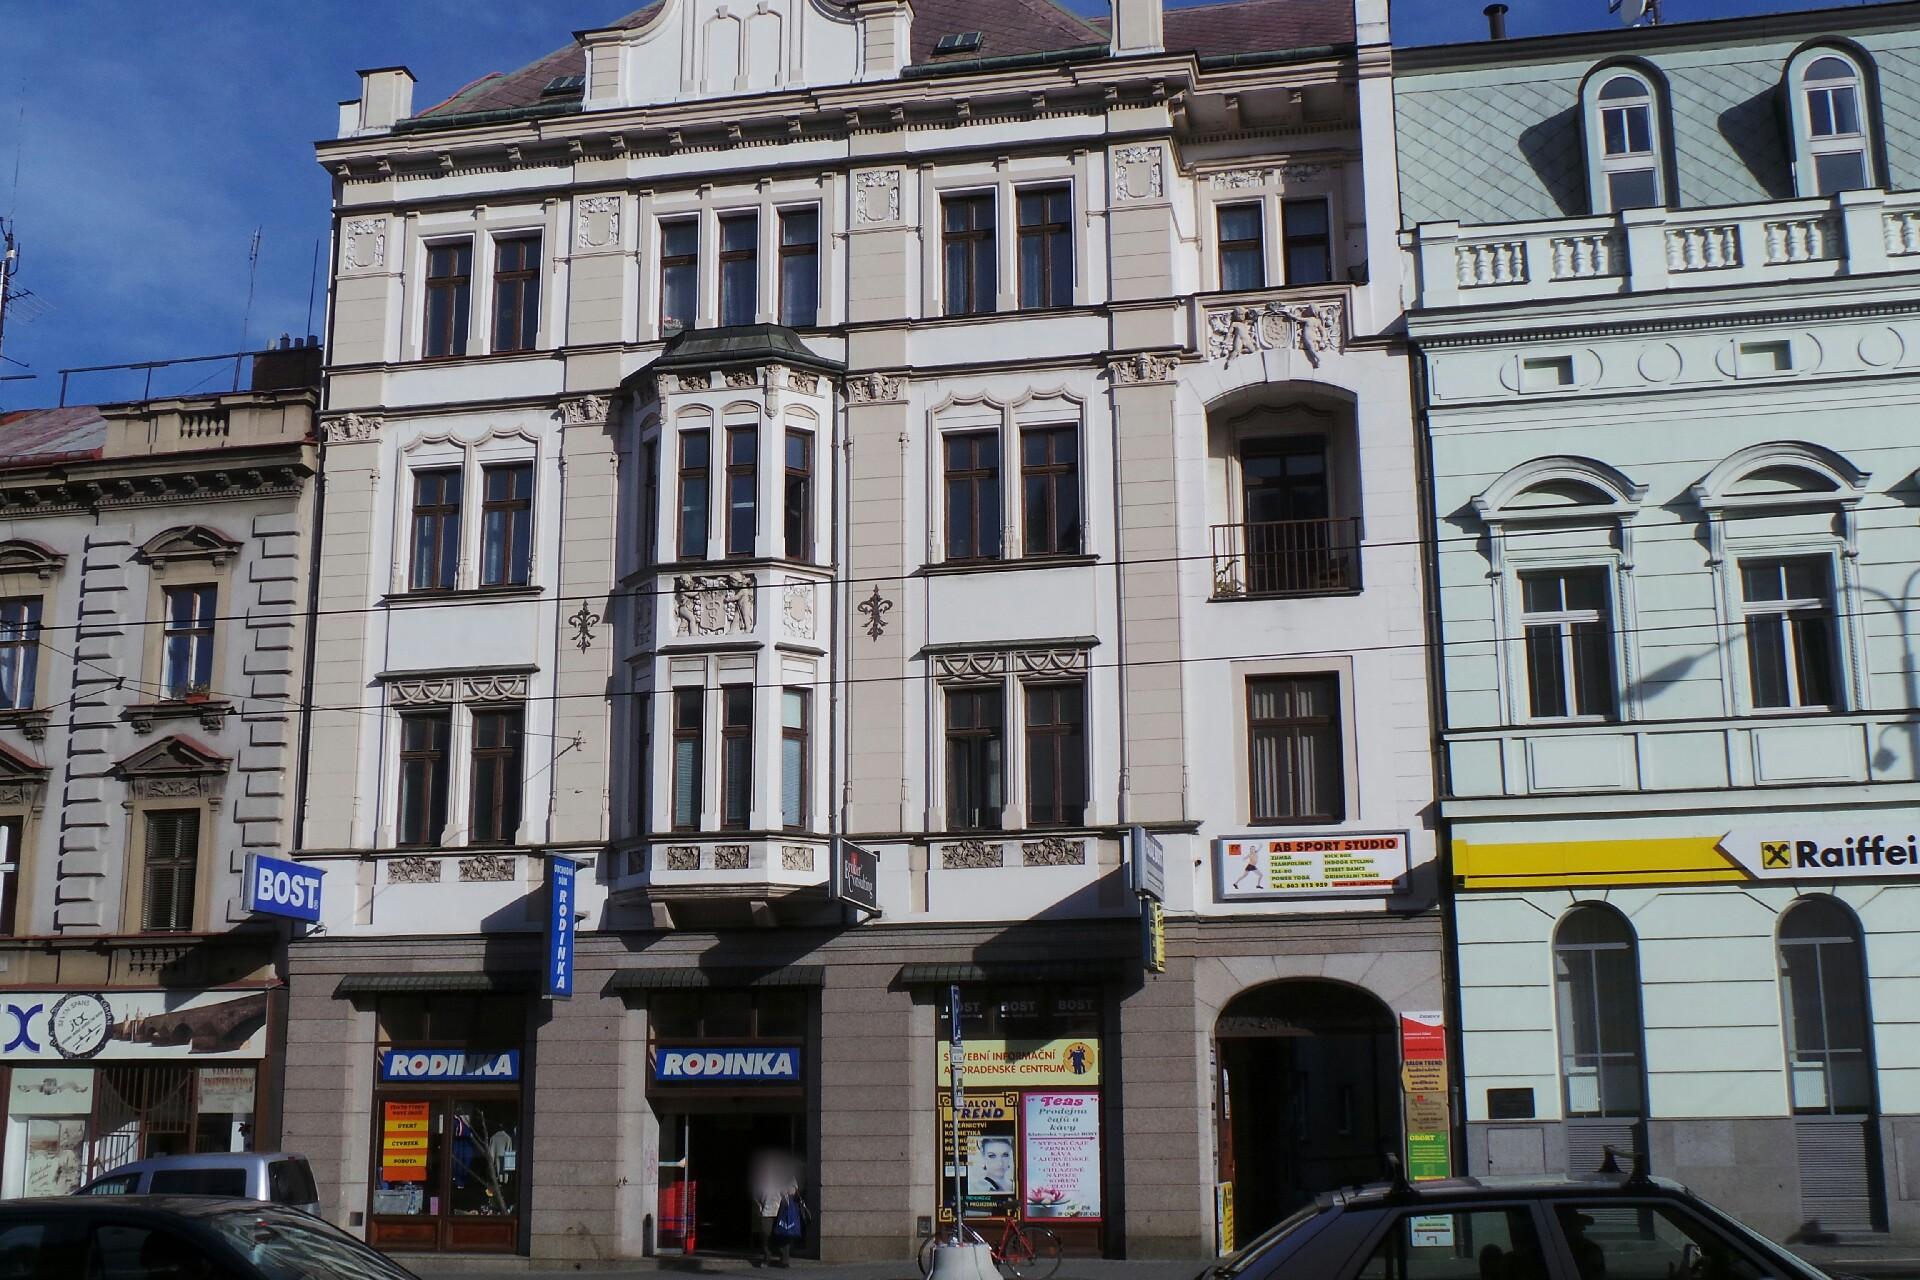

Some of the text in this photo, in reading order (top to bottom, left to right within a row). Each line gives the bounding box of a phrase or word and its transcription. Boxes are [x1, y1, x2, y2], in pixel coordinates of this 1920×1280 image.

[1274, 840, 1396, 852] AB SPORT STUDIO
[556, 890, 568, 989] RODINKA
[1058, 1000, 1094, 1010] BOST
[944, 1050, 990, 1061] SEBNÍ
[992, 1049, 1056, 1060] INFORMAČNÍ
[390, 1054, 512, 1076] RODINKA
[663, 1053, 792, 1076] RODINKA
[962, 1064, 1016, 1074] ORADENSKÉ
[1020, 1064, 1065, 1073] CENTRUM
[1041, 1096, 1084, 1107] Teas
[957, 1108, 1004, 1118] REND
